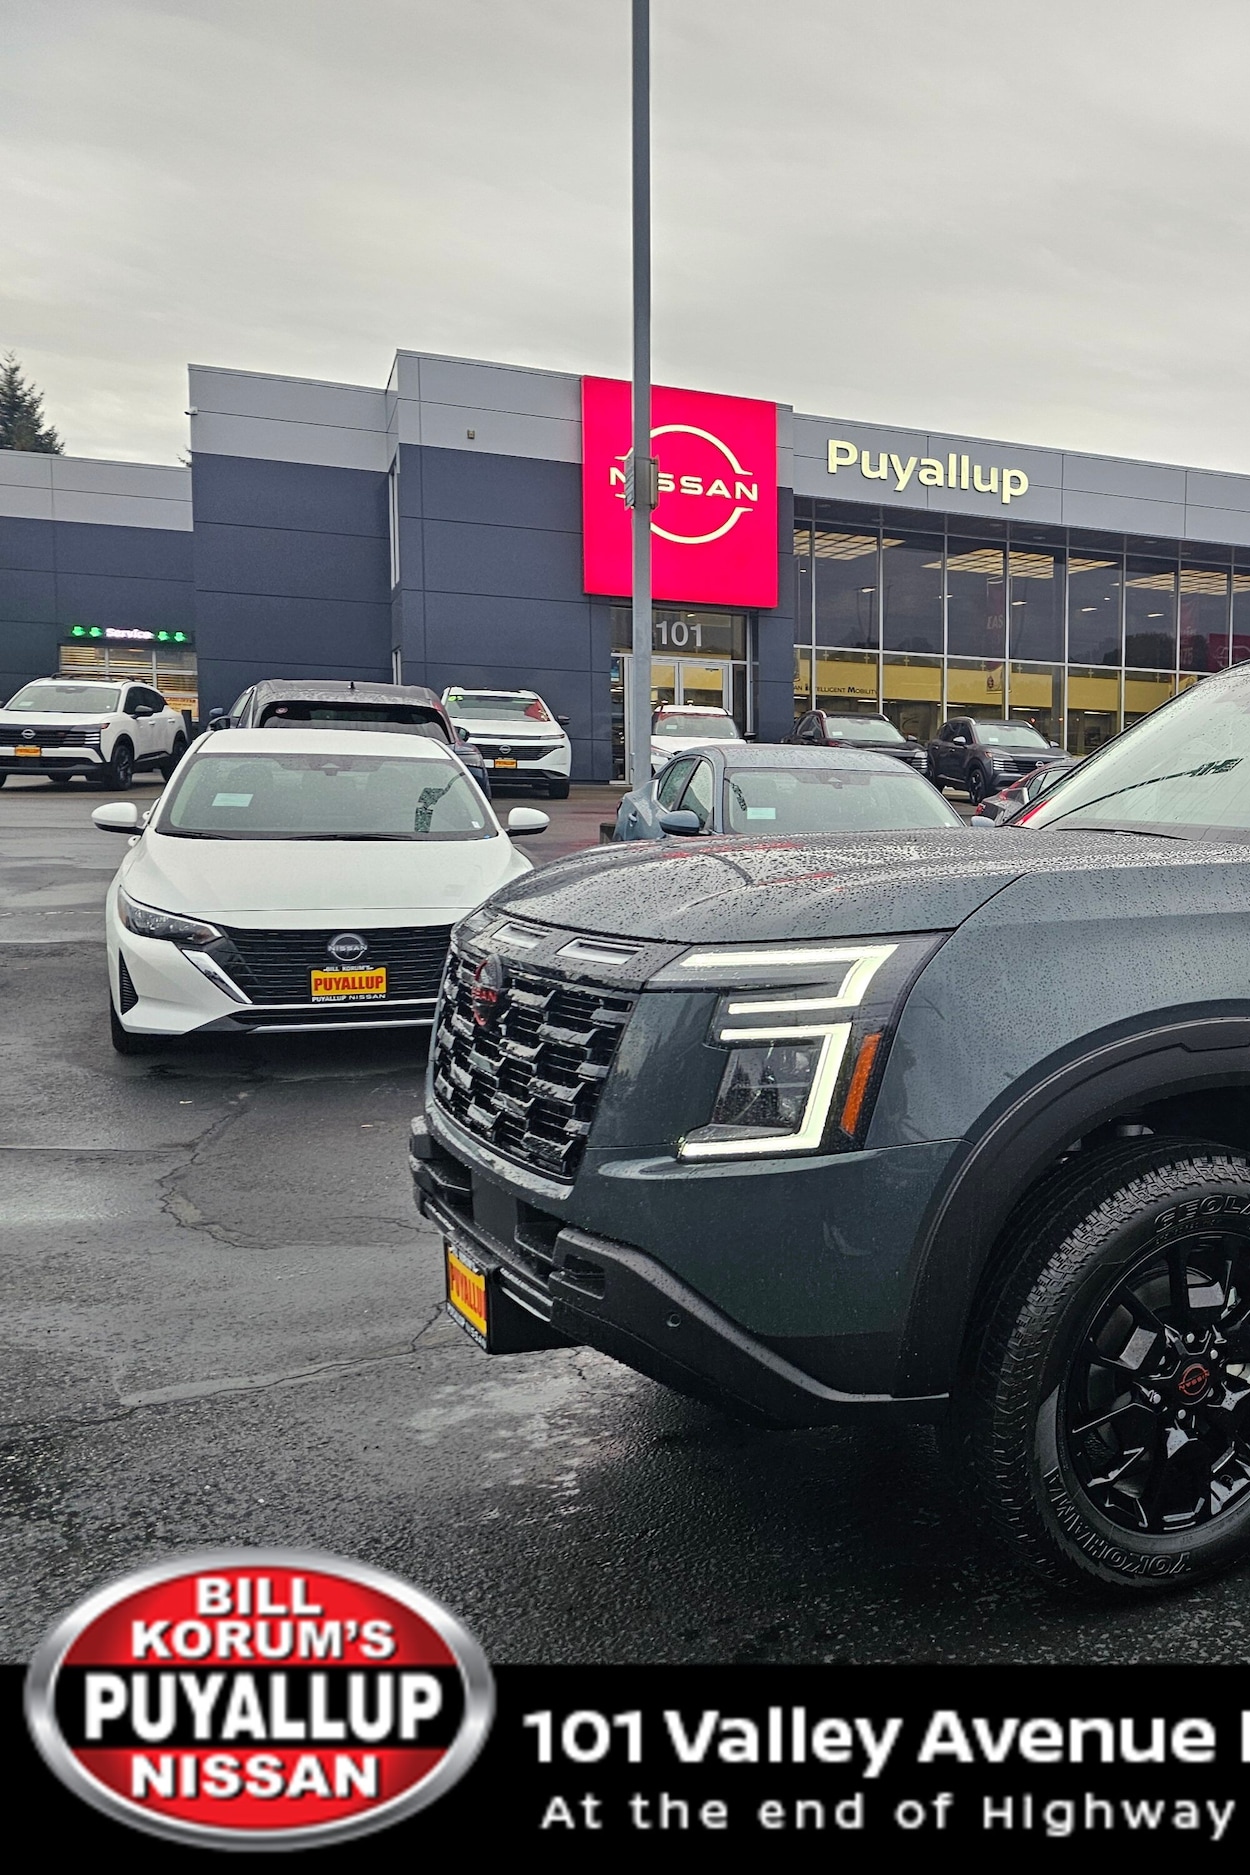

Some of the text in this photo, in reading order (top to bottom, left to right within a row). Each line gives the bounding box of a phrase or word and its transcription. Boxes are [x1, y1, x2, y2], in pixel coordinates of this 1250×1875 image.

[828, 439, 1029, 504] Puyallup
[609, 466, 758, 502] NSSAN
[105, 627, 155, 640] Service
[655, 620, 703, 648] 101
[327, 944, 368, 952] NISSAN
[313, 975, 384, 992] PUYALLUP
[348, 993, 387, 1001] NISSAN
